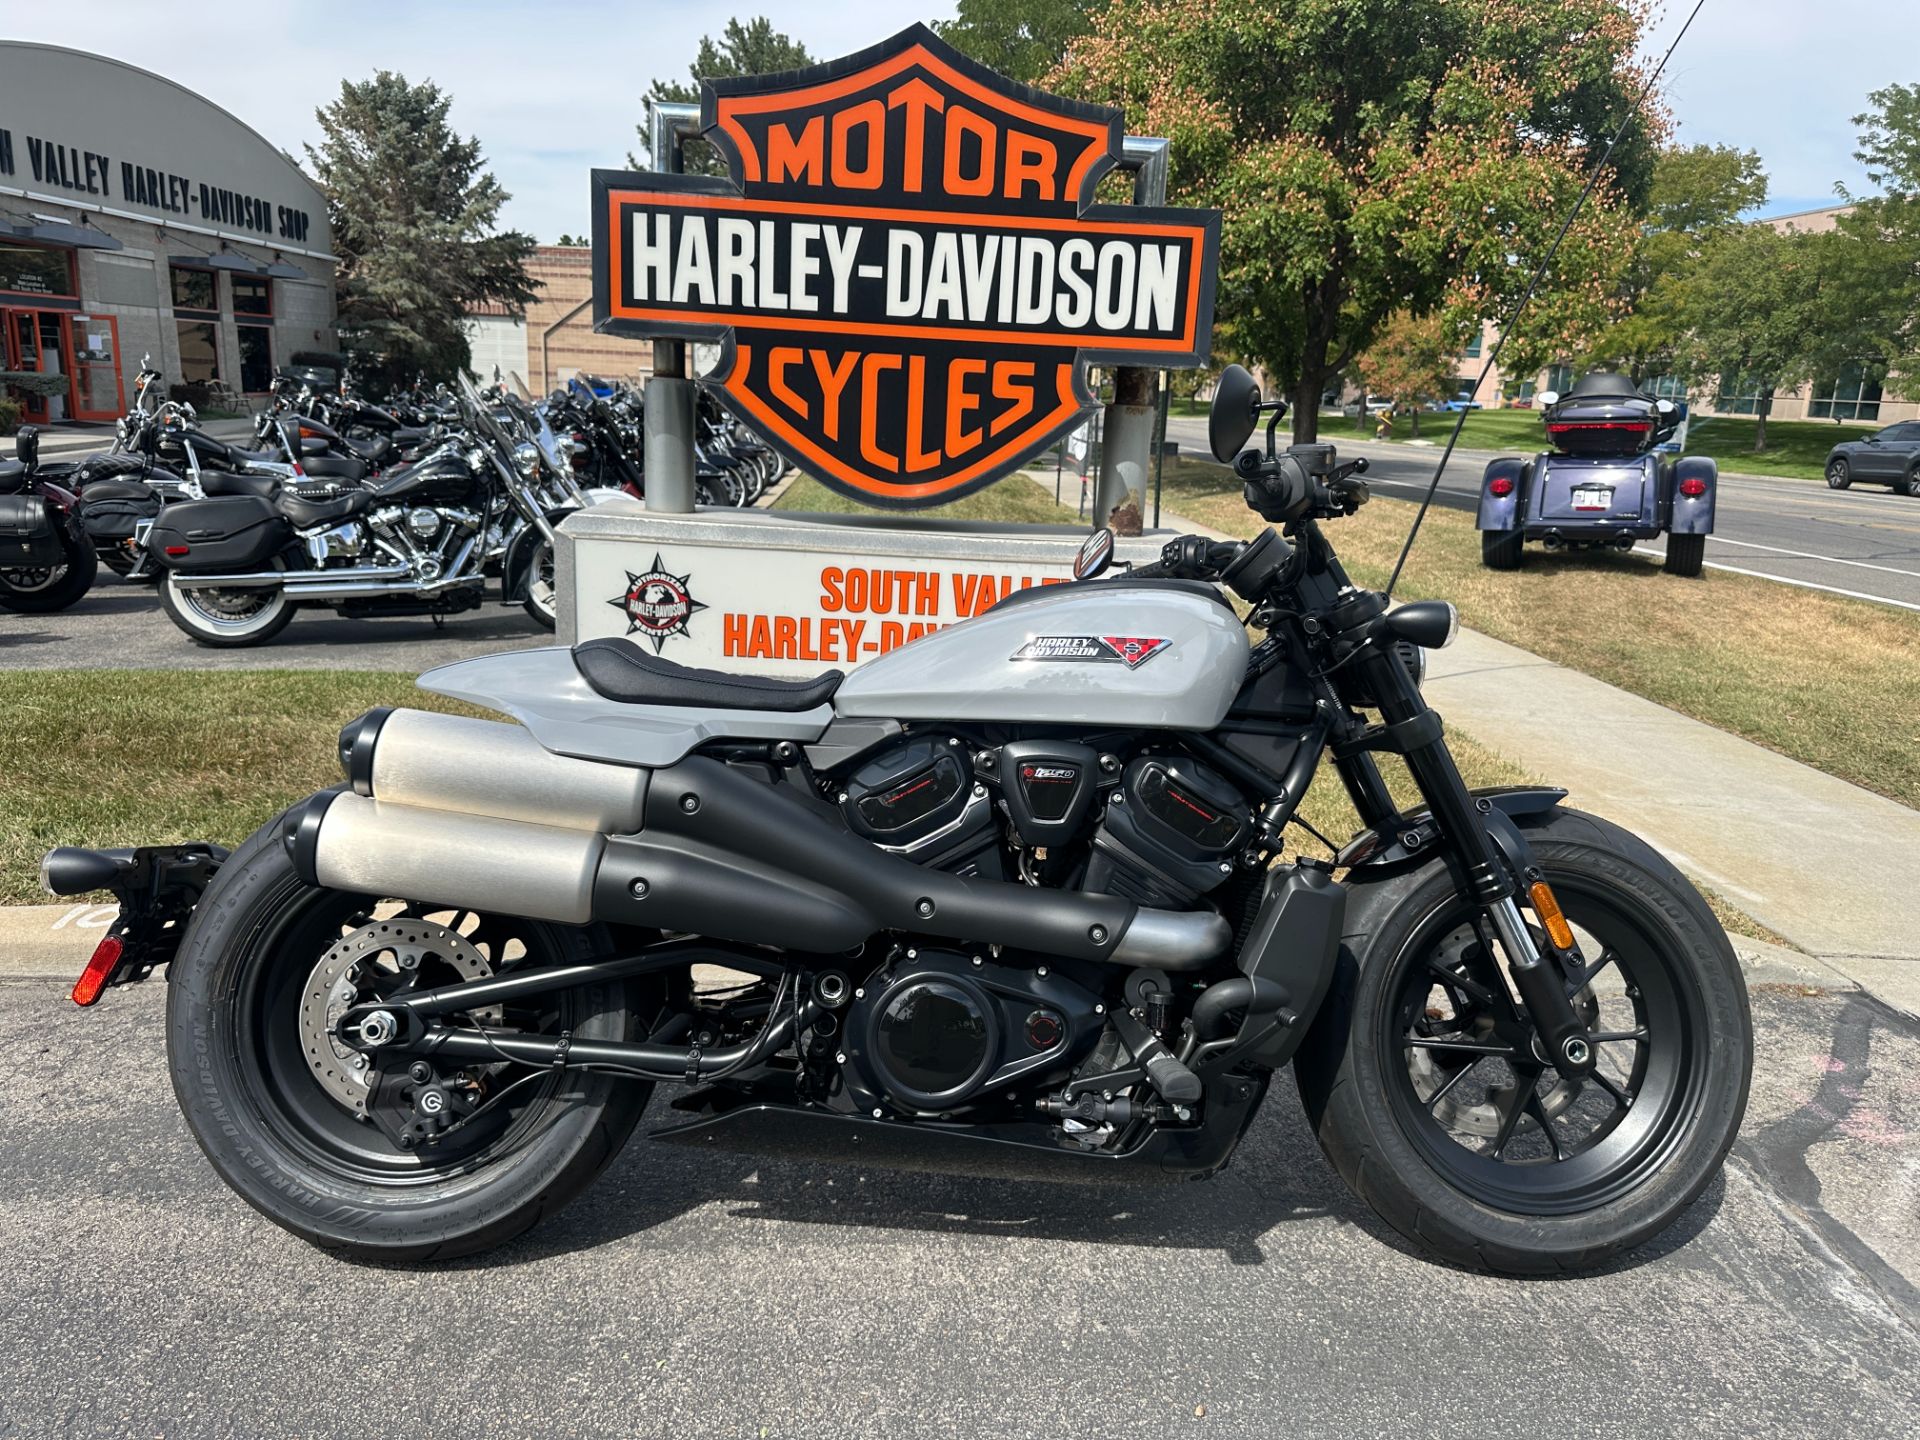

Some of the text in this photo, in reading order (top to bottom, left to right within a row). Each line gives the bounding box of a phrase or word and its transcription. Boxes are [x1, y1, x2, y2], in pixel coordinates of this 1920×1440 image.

[767, 77, 1057, 200] MOTOR
[26, 136, 109, 196] VALLEY
[121, 162, 272, 234] HARLEY-DAVIDSON
[278, 205, 309, 242] SHOP
[632, 211, 1181, 332] HARLEY-DAVIDSON
[768, 346, 1035, 474] CYCLES
[629, 599, 687, 618] HARLEY-DAVIDSON
[631, 573, 685, 593] AUTHORIZED
[820, 567, 940, 616] SOUTH
[633, 619, 683, 636] RENTALS
[1025, 647, 1099, 656] DAVIDSON
[193, 1023, 321, 1208] HARLEY-DAVIDSON
